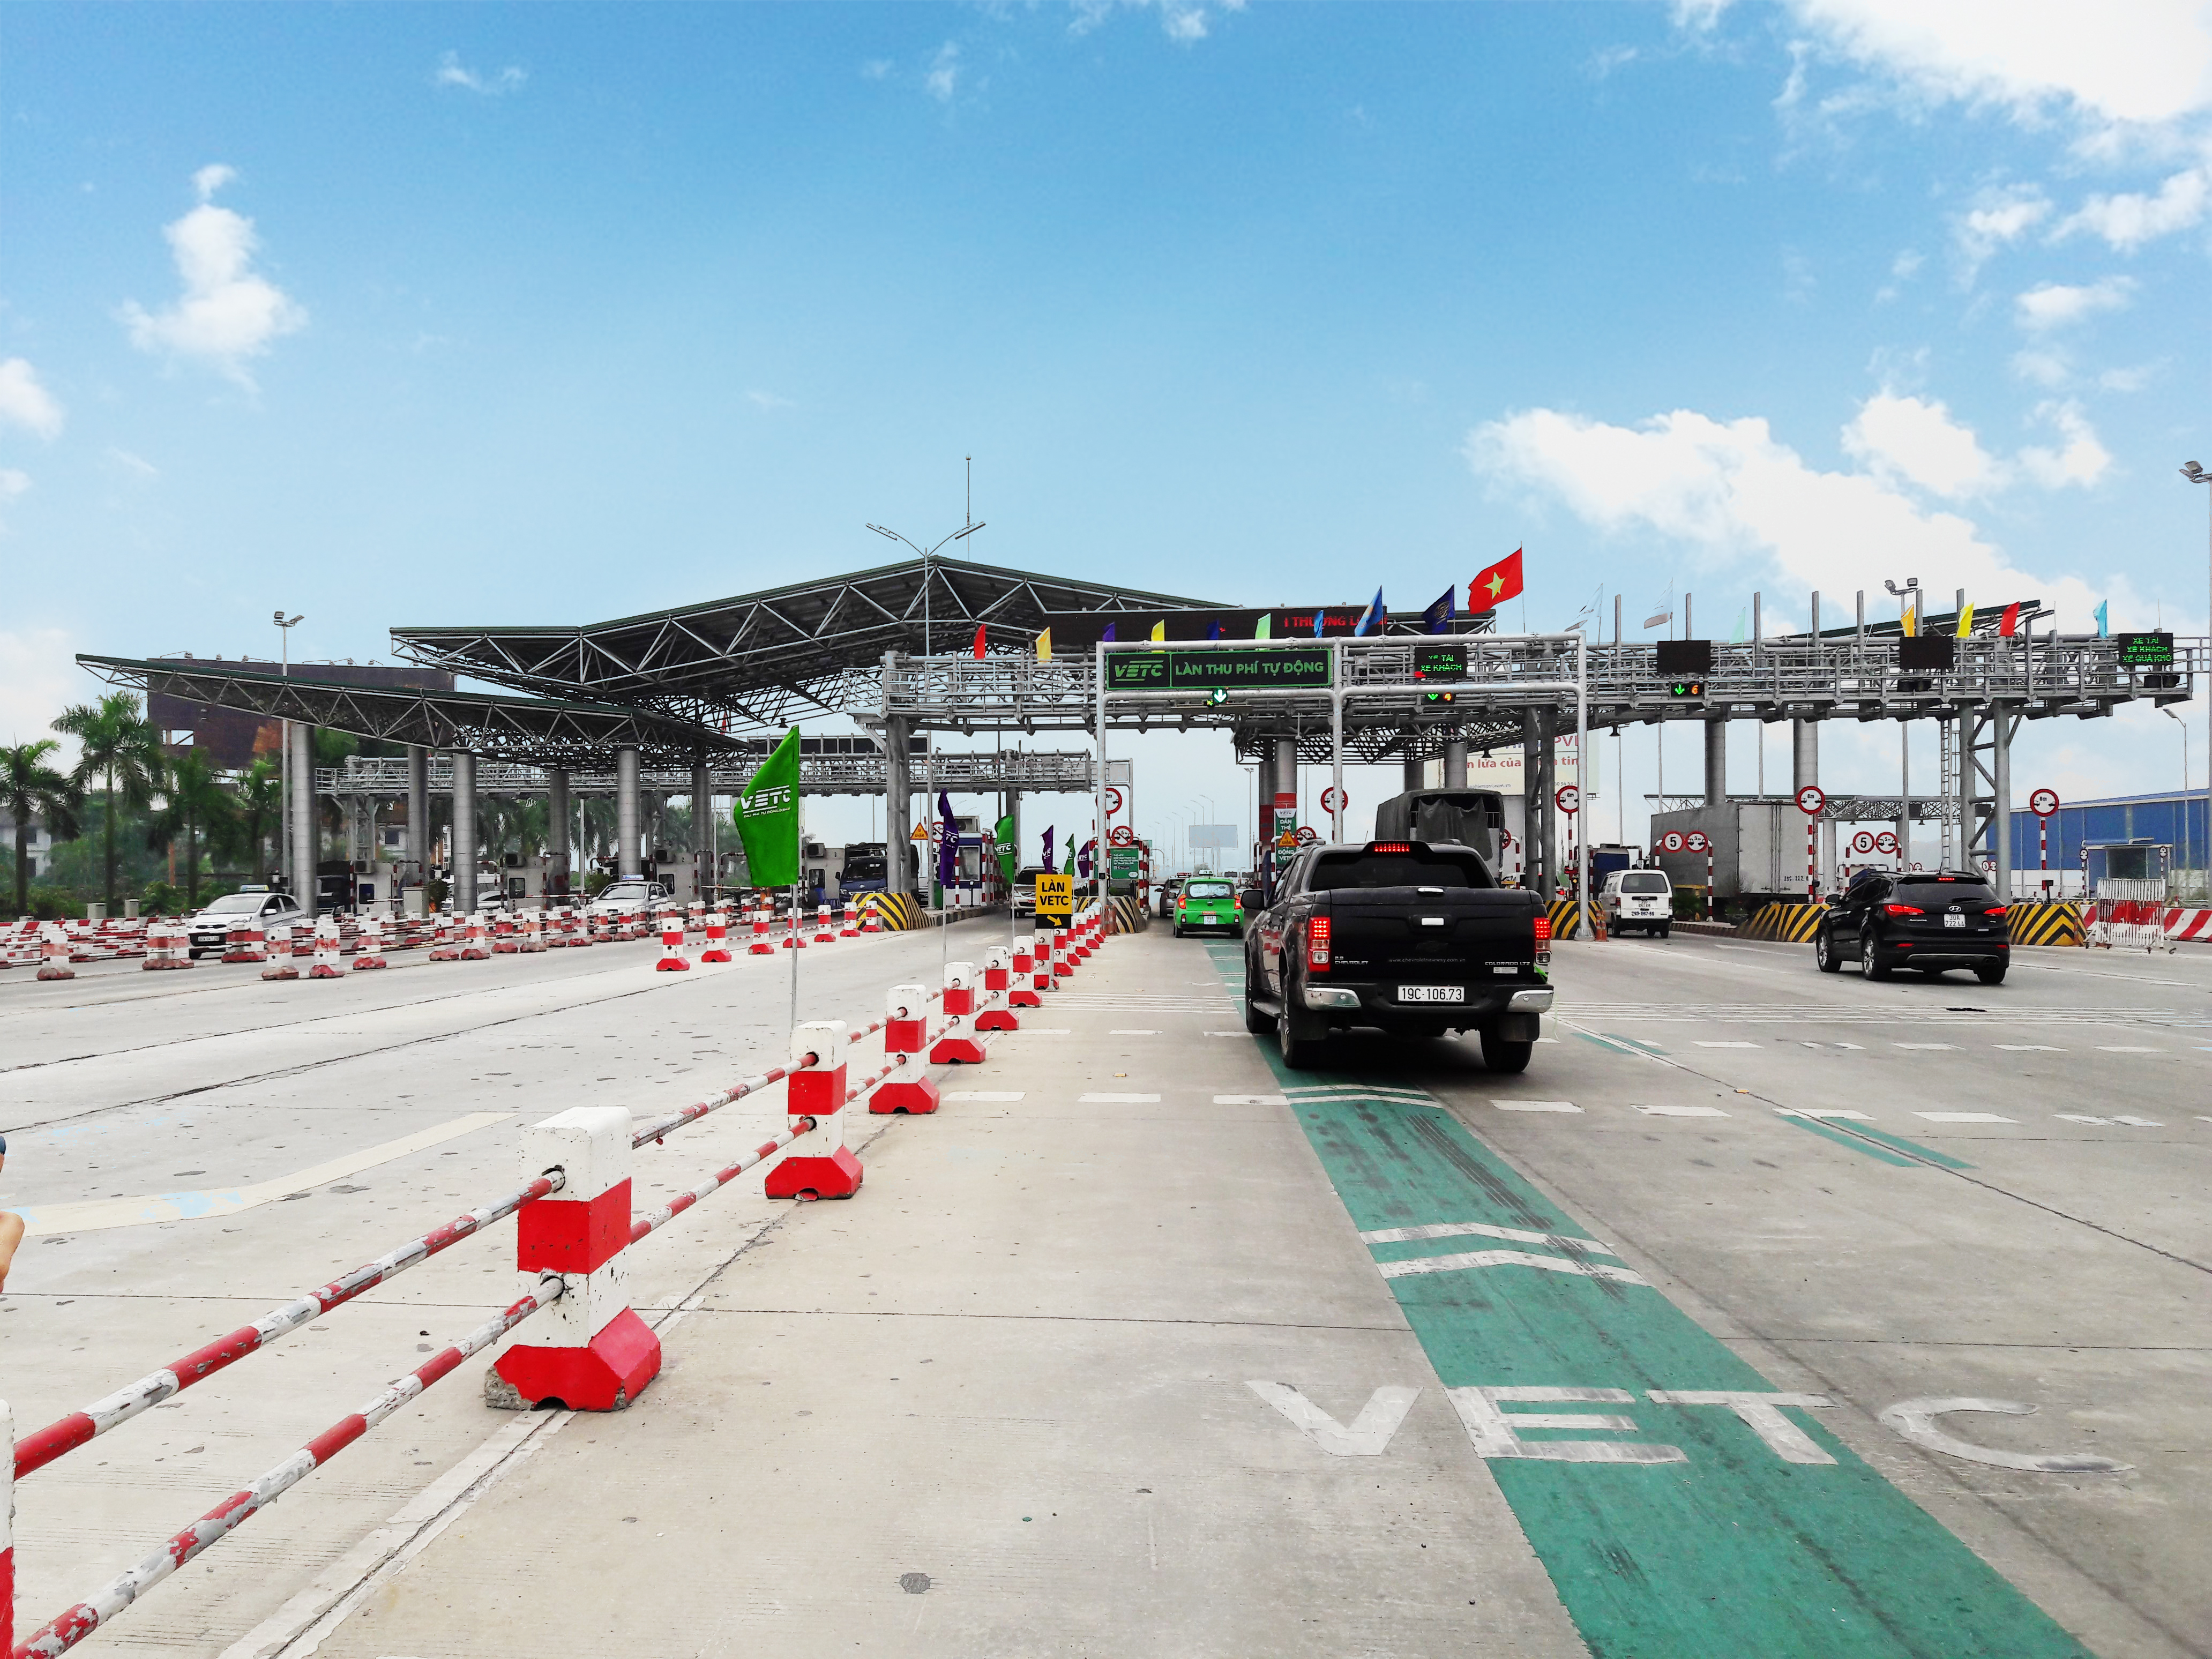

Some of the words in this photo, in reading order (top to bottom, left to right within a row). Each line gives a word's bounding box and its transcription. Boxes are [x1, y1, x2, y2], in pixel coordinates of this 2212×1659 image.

[1115, 663, 1164, 677] VETC
[1176, 661, 1202, 676] LÀN
[1206, 664, 1232, 675] THU
[1236, 660, 1259, 675] PHÍ
[1262, 662, 1280, 677] TỰ
[1283, 659, 1325, 676] ĐỘNG
[1500, 757, 1521, 767] của
[741, 788, 791, 810] VETC
[1670, 836, 1677, 847] 5
[1860, 837, 1867, 848] 5
[1042, 879, 1065, 892] LÀN
[1040, 895, 1069, 906] VETC
[1245, 1384, 2136, 1473] VETC
